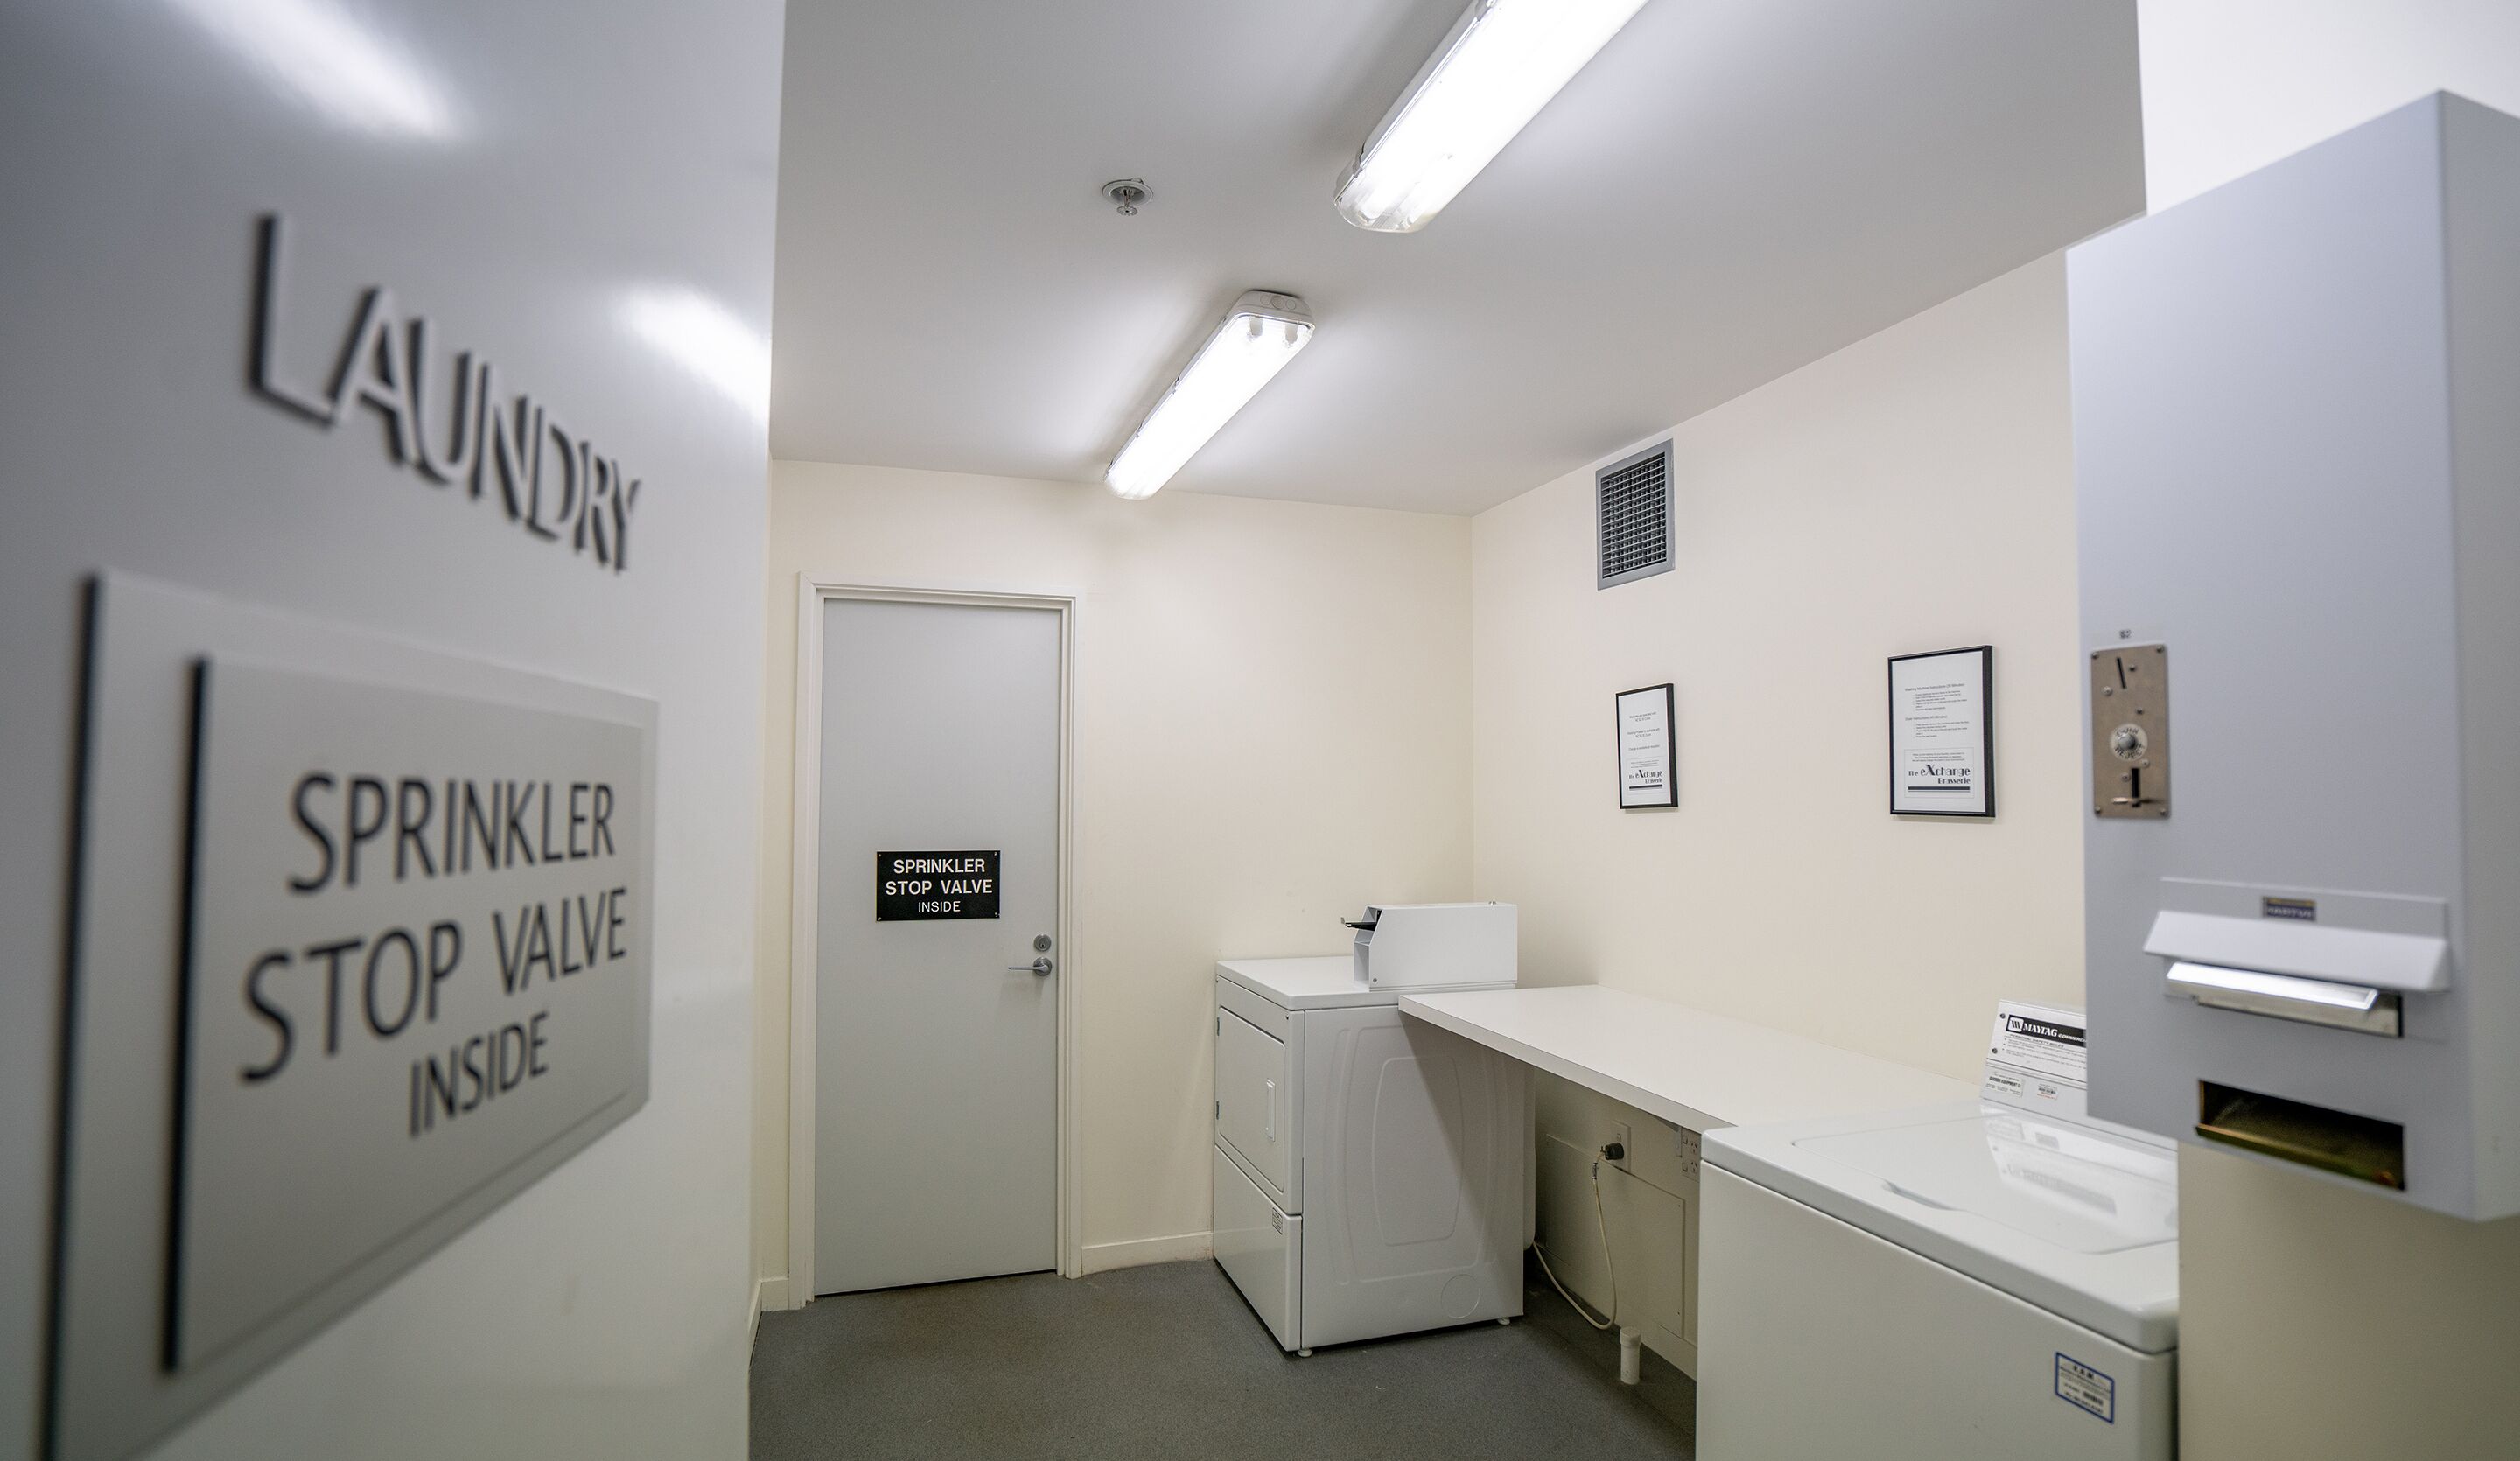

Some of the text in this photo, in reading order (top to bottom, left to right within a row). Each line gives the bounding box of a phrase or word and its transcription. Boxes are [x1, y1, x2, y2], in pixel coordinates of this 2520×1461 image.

[248, 210, 641, 574] LAUNDRY
[285, 770, 619, 898] SPRINKLER
[892, 858, 986, 874] SPRINKLER
[885, 879, 993, 896] STOP VALVE
[918, 900, 962, 912] INSIDE
[238, 884, 629, 1087] STOP VALVE
[2022, 1023, 2058, 1038] MAYTAG
[406, 1008, 552, 1139] INSIDE
